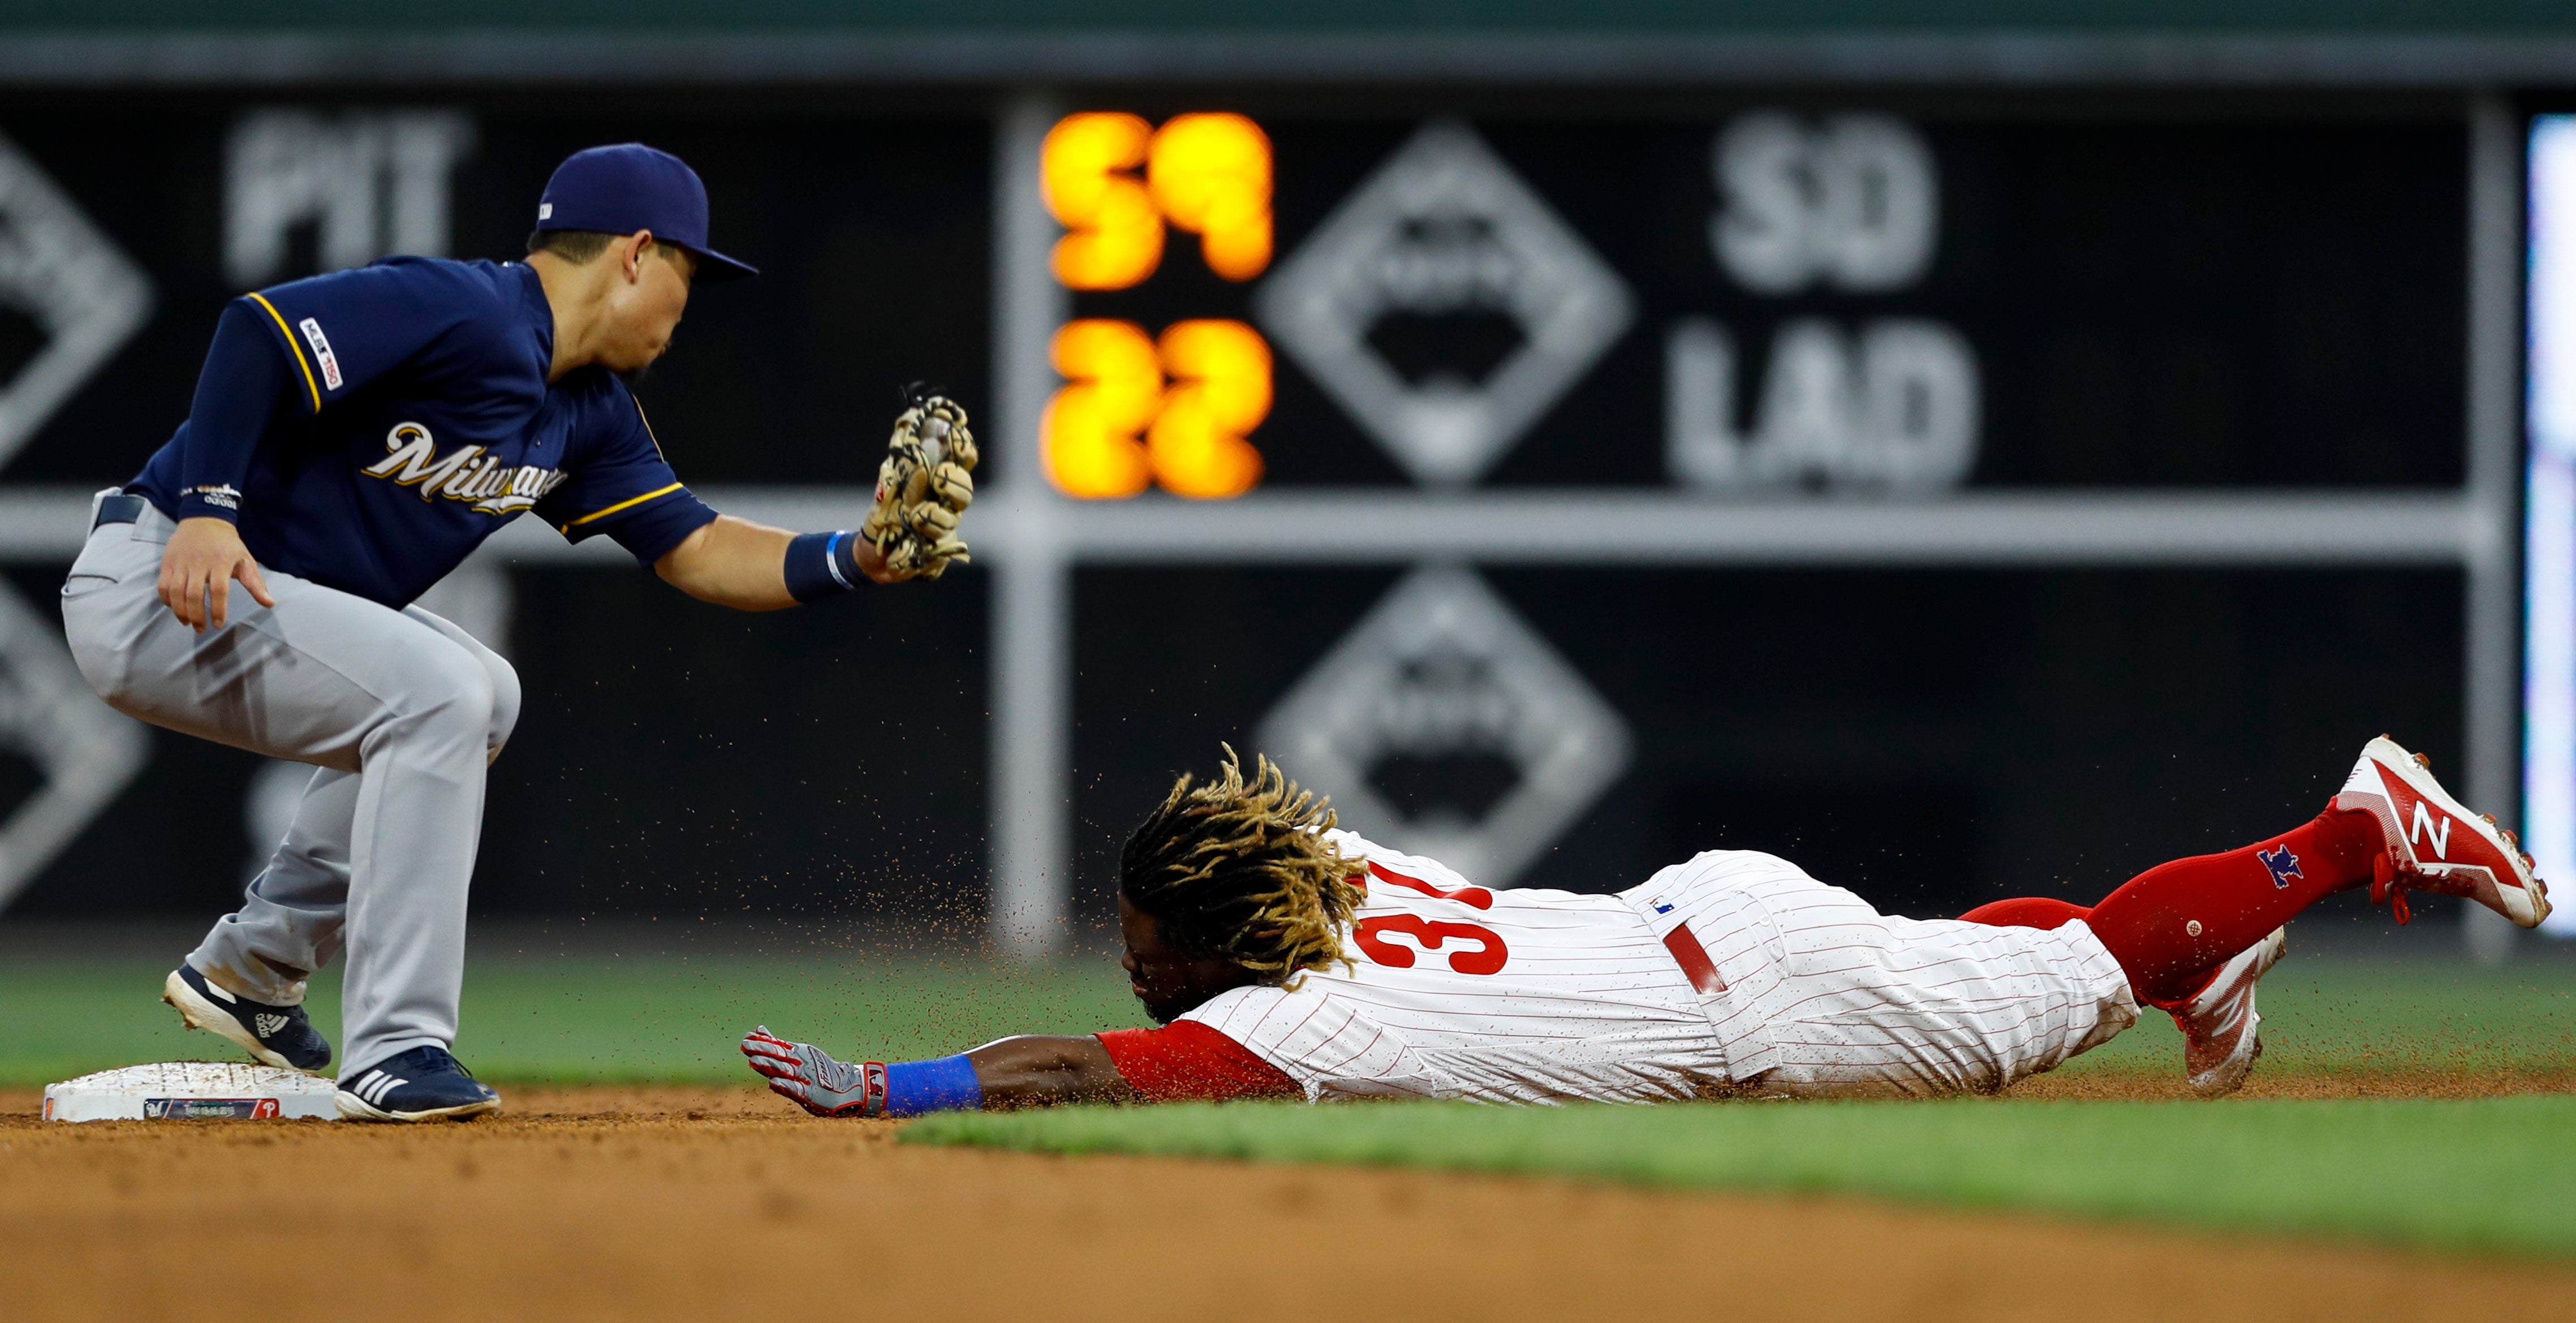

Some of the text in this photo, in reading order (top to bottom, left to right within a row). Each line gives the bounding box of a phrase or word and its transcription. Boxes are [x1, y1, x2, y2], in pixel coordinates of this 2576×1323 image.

[226, 109, 474, 284] PIT
[1040, 111, 1275, 291] 59
[1708, 110, 1940, 294] SD
[305, 323, 325, 350] MLB
[1040, 317, 1275, 499] 22
[1662, 316, 1982, 490] LAD
[255, 1013, 271, 1038] adidas
